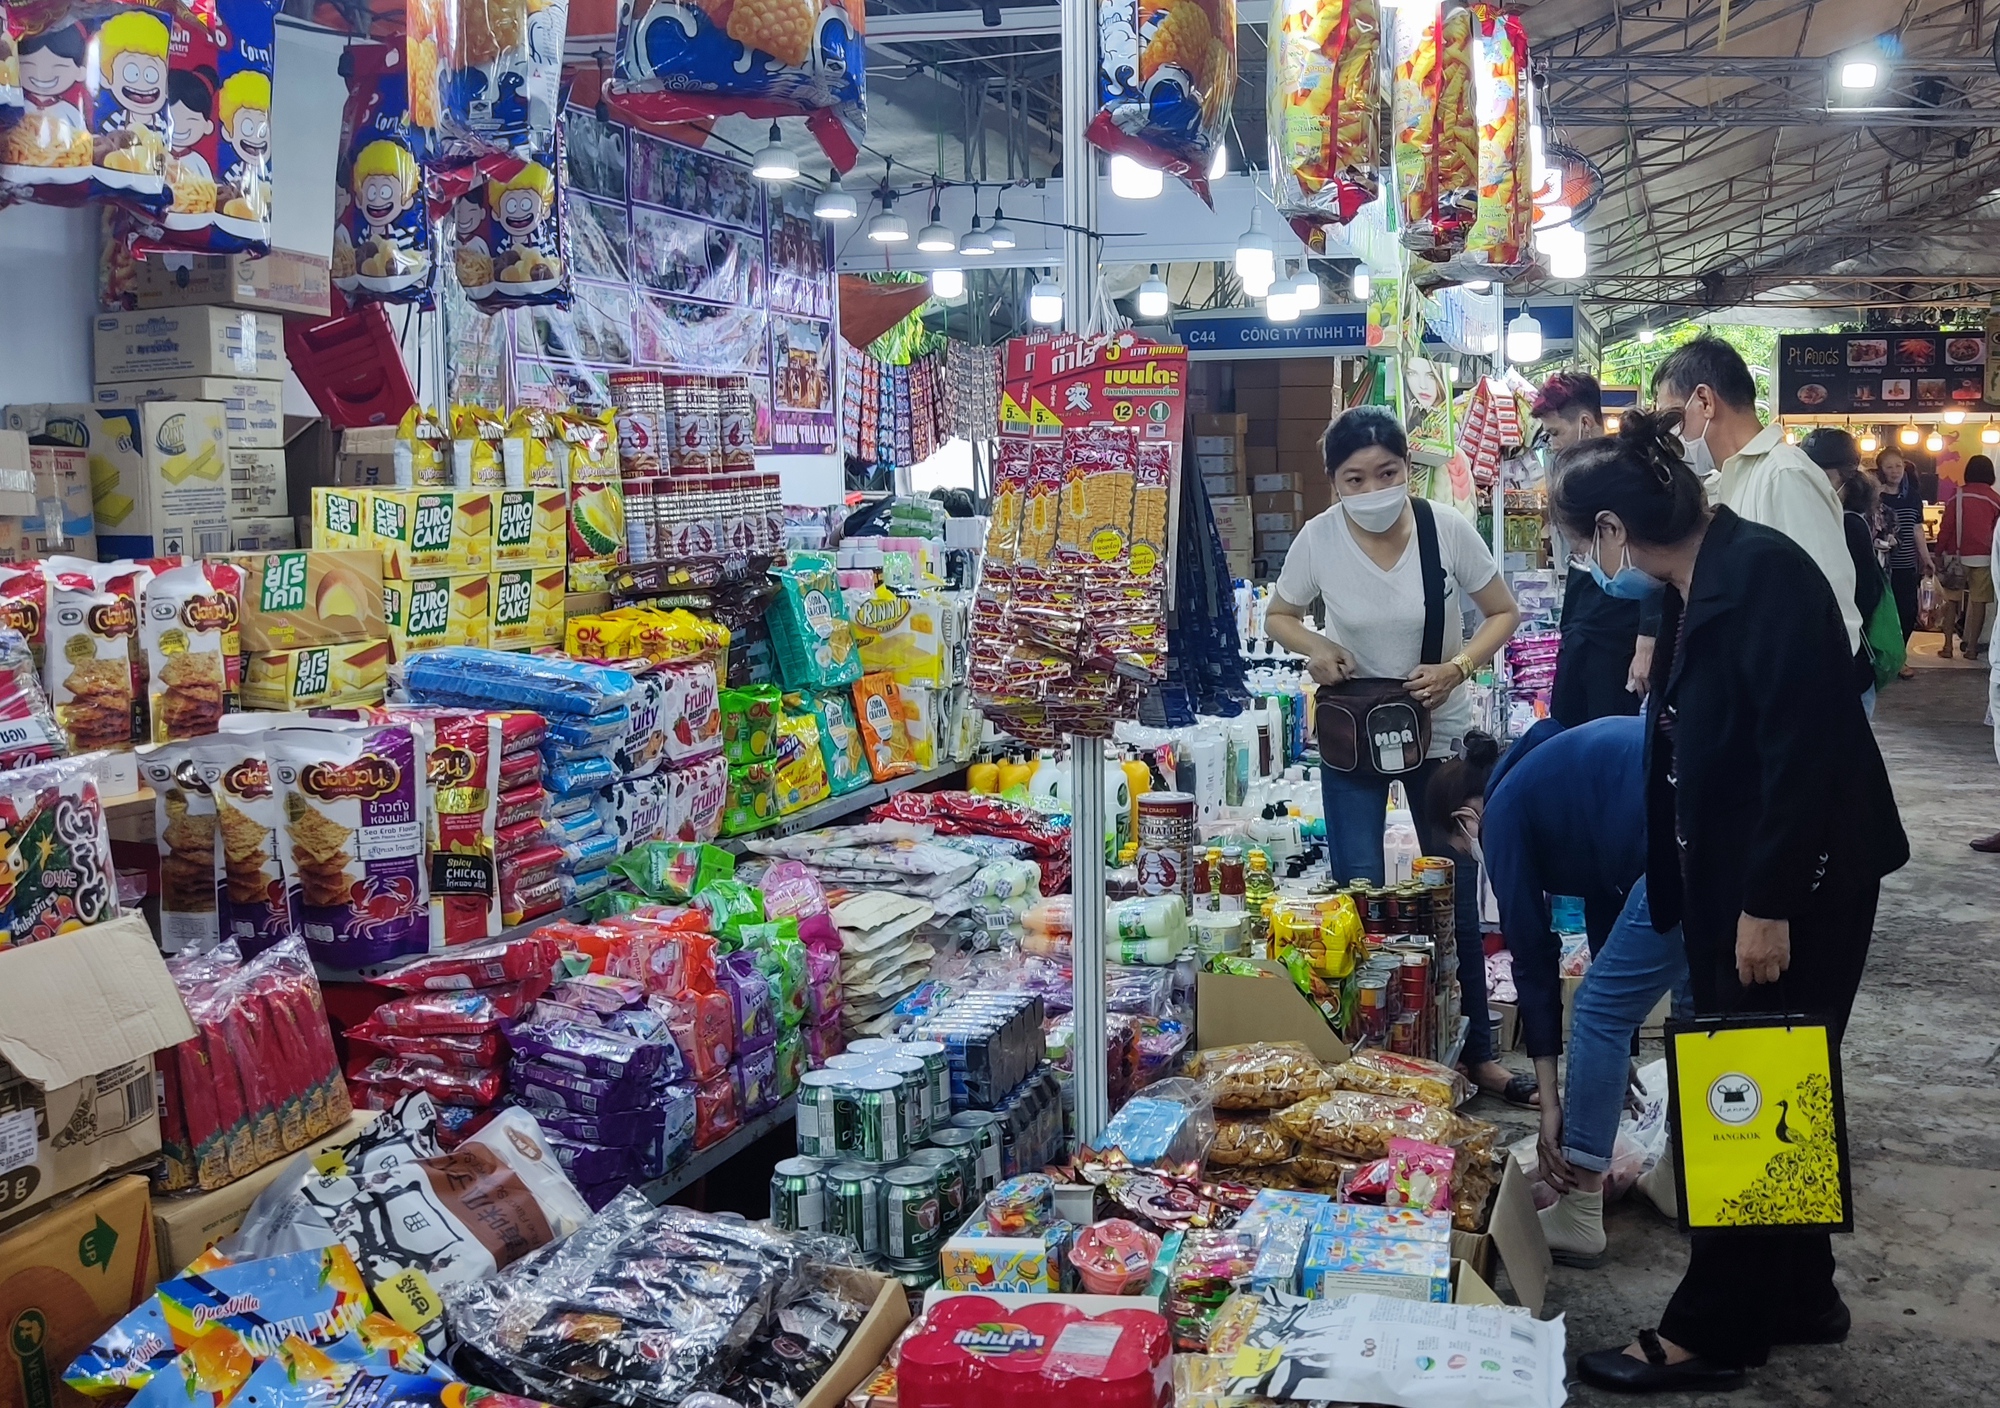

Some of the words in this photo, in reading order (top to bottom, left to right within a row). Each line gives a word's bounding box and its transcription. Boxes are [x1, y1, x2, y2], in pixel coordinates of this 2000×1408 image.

[1189, 331, 1216, 343] C44
[1240, 326, 1280, 342] CÔNG
[1283, 327, 1302, 340] TY
[1305, 326, 1343, 340] TNHH
[1104, 361, 1179, 385] เบนโตะ
[1115, 405, 1131, 416] 12
[1154, 402, 1163, 420] 1
[1073, 450, 1127, 464] Bento
[327, 494, 340, 531] CAKE
[337, 497, 351, 534] EURO
[373, 498, 388, 536] CAKE
[384, 501, 398, 539] EURO
[415, 504, 452, 530] EURO
[501, 502, 533, 525] EURO
[413, 523, 450, 548] CAKE
[499, 520, 531, 542] CAKE
[263, 587, 303, 611] เค้ก
[411, 588, 449, 615] EURO
[499, 581, 531, 605] EURO
[807, 594, 822, 605] SODA
[409, 607, 447, 633] CAKE
[497, 599, 529, 622] CAKE
[807, 604, 827, 617] CRACKER
[862, 599, 908, 625] RINNY
[577, 627, 603, 643] OK
[639, 628, 668, 642] OK
[671, 639, 689, 650] OK
[684, 682, 714, 714] Fruity
[869, 699, 883, 709] SODA
[688, 704, 707, 719] BISCUIT
[749, 701, 771, 718] OK
[869, 707, 887, 719] CRACKER
[625, 728, 649, 746] BISCUIT
[1375, 729, 1414, 747] MDR
[690, 783, 725, 816] Fruity
[370, 811, 410, 825] หอมมะลิ
[631, 802, 665, 832] Fruity
[634, 824, 654, 839] BISCUIT
[446, 858, 472, 869] Spicy
[1713, 1132, 1761, 1141] BANGKOK
[5, 1147, 35, 1165] 10.05.2022
[14, 1176, 28, 1200] g
[83, 1235, 97, 1263] UP
